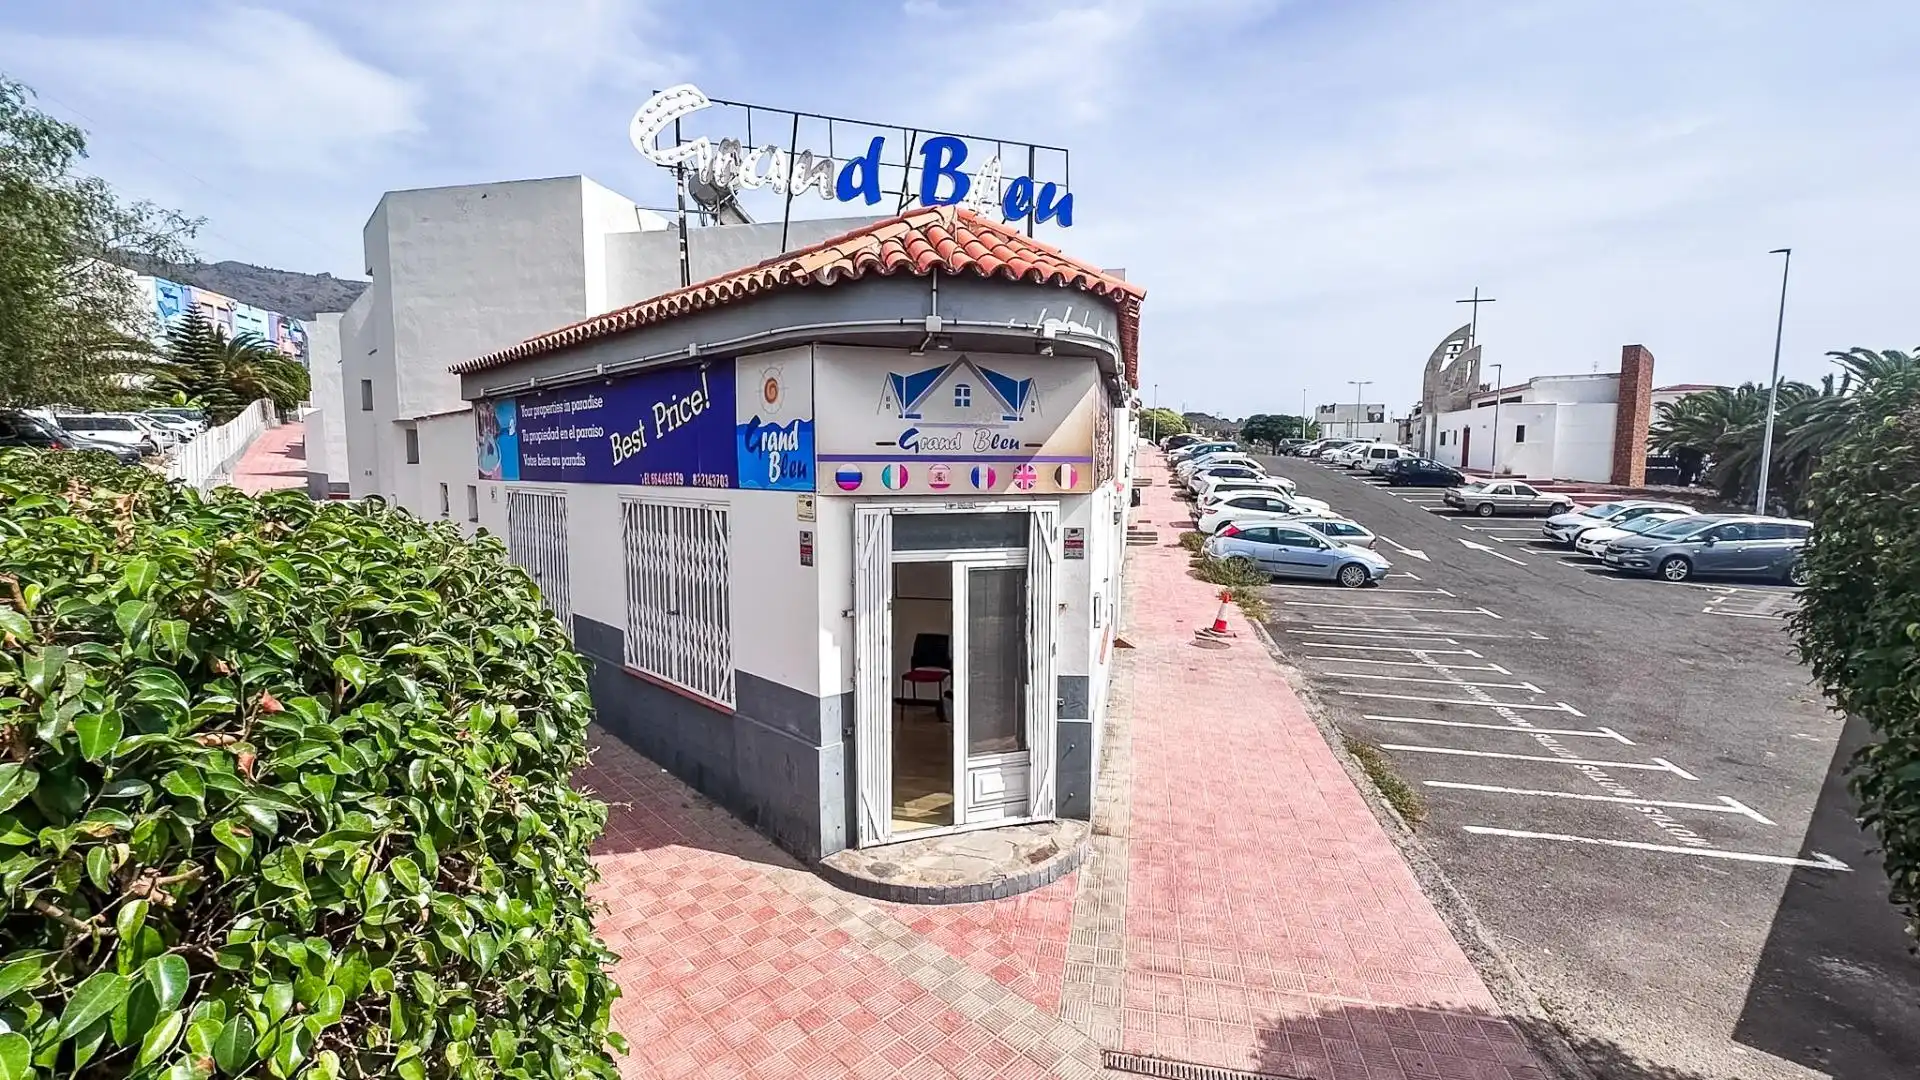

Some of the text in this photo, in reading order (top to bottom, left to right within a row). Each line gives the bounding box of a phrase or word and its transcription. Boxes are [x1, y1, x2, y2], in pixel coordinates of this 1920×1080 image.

[629, 83, 1074, 228] Grand Bleu
[521, 394, 603, 419] Your properties in paradise
[610, 371, 710, 466] Best Price!
[521, 429, 529, 442] Tu
[529, 426, 559, 444] propiedad
[560, 430, 568, 440] en
[569, 424, 576, 440] el
[744, 414, 799, 460] Grand
[898, 427, 1020, 454] Grand Bleu
[537, 453, 551, 466] bien
[551, 456, 560, 466] au
[561, 452, 586, 469] paradis
[768, 450, 807, 483] Bleu
